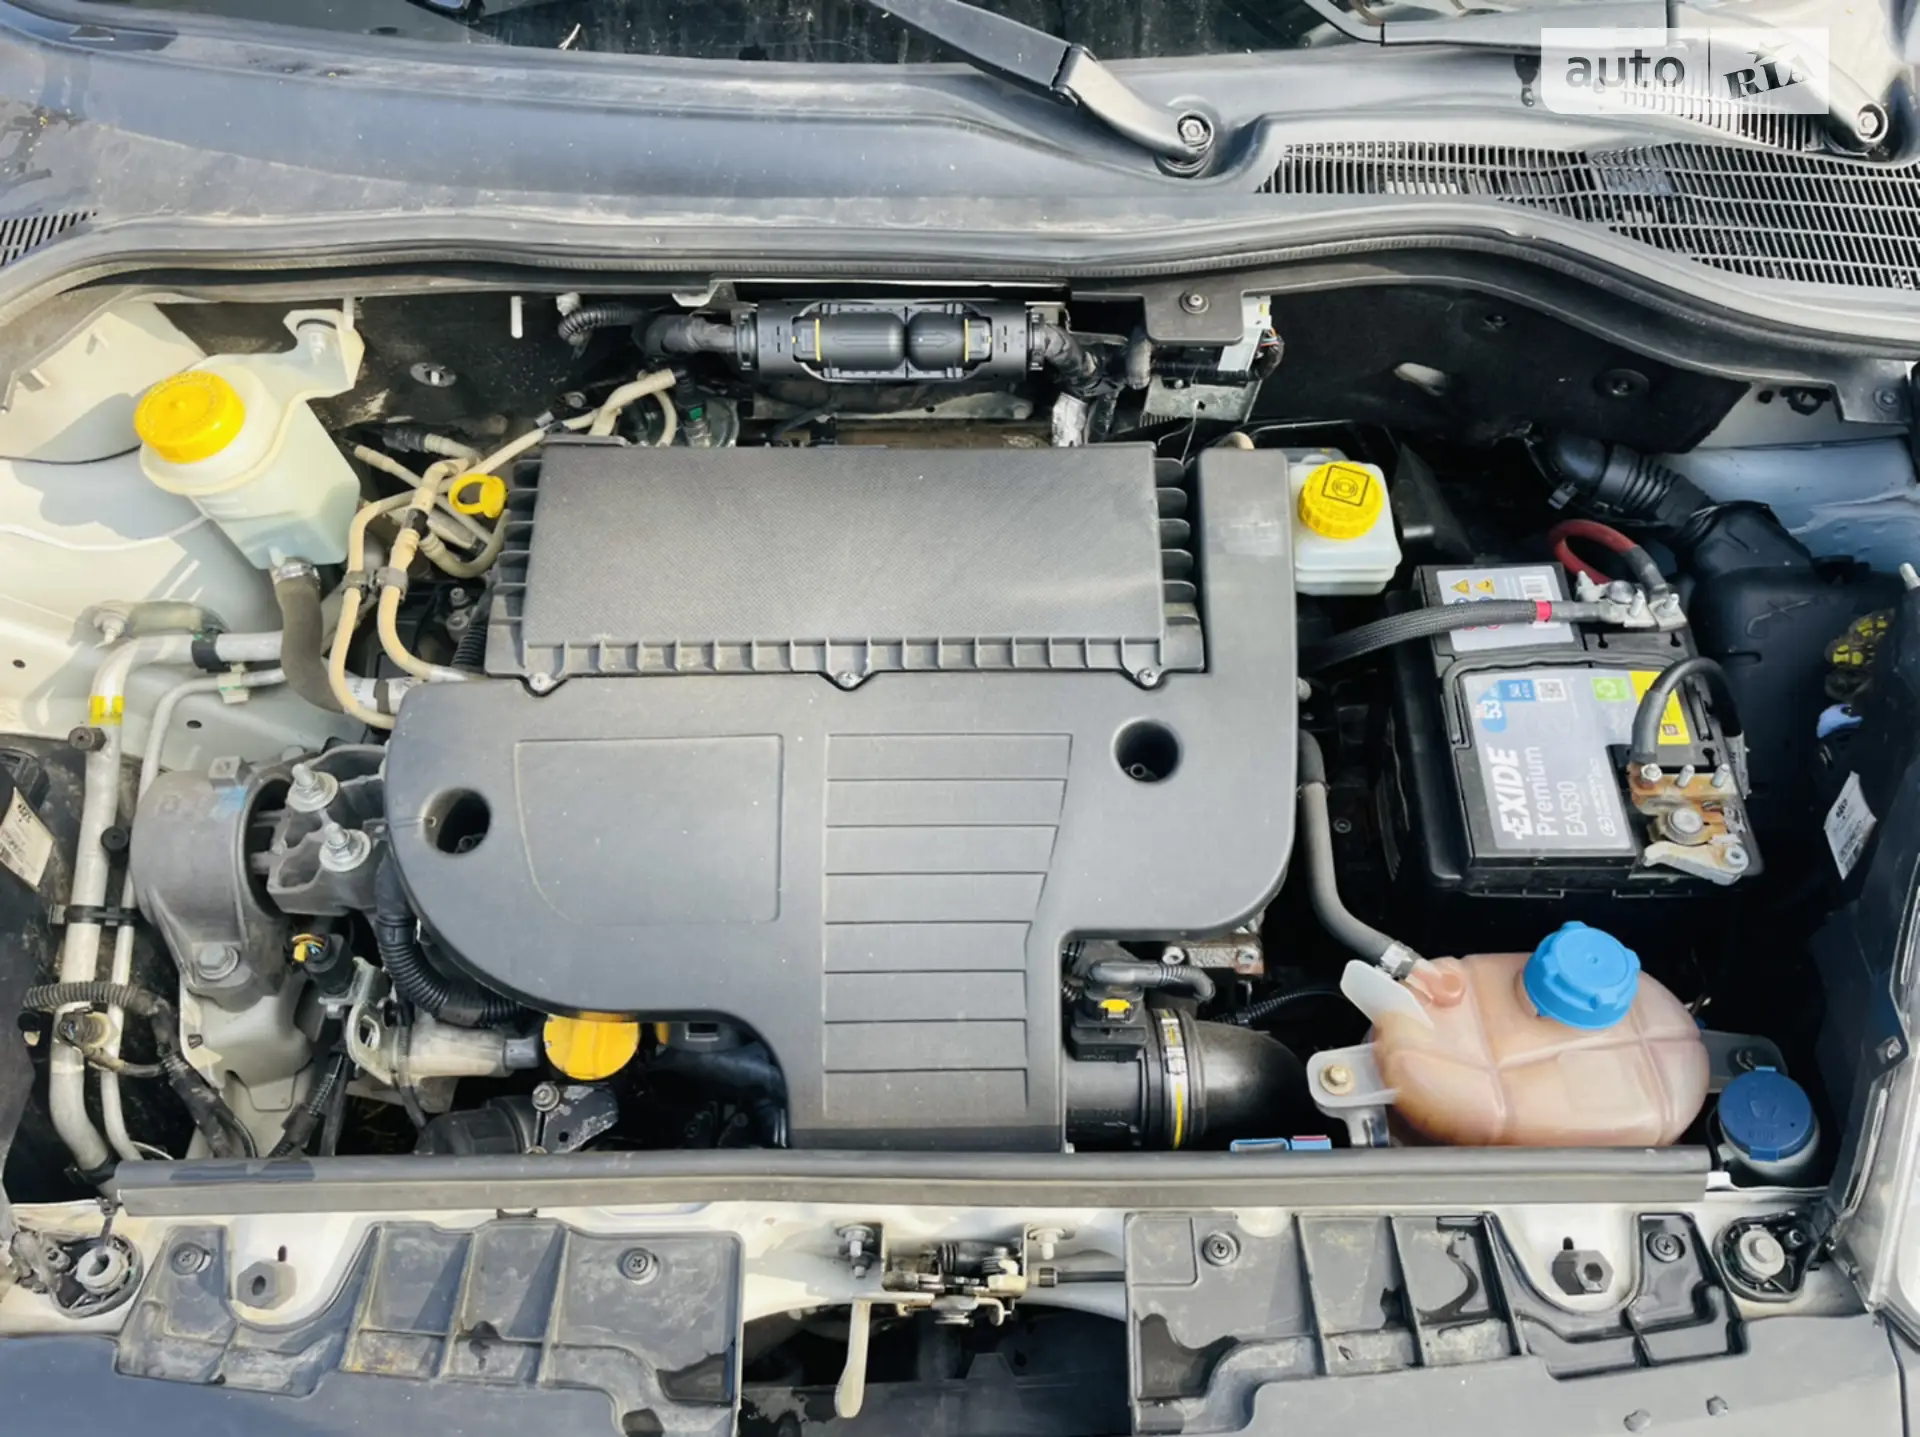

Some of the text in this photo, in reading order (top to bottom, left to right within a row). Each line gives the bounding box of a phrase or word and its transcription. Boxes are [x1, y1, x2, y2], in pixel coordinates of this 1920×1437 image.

[1486, 745, 1534, 840] EXIDE
[1524, 746, 1560, 837] Premium
[1557, 780, 1589, 837] EA530
